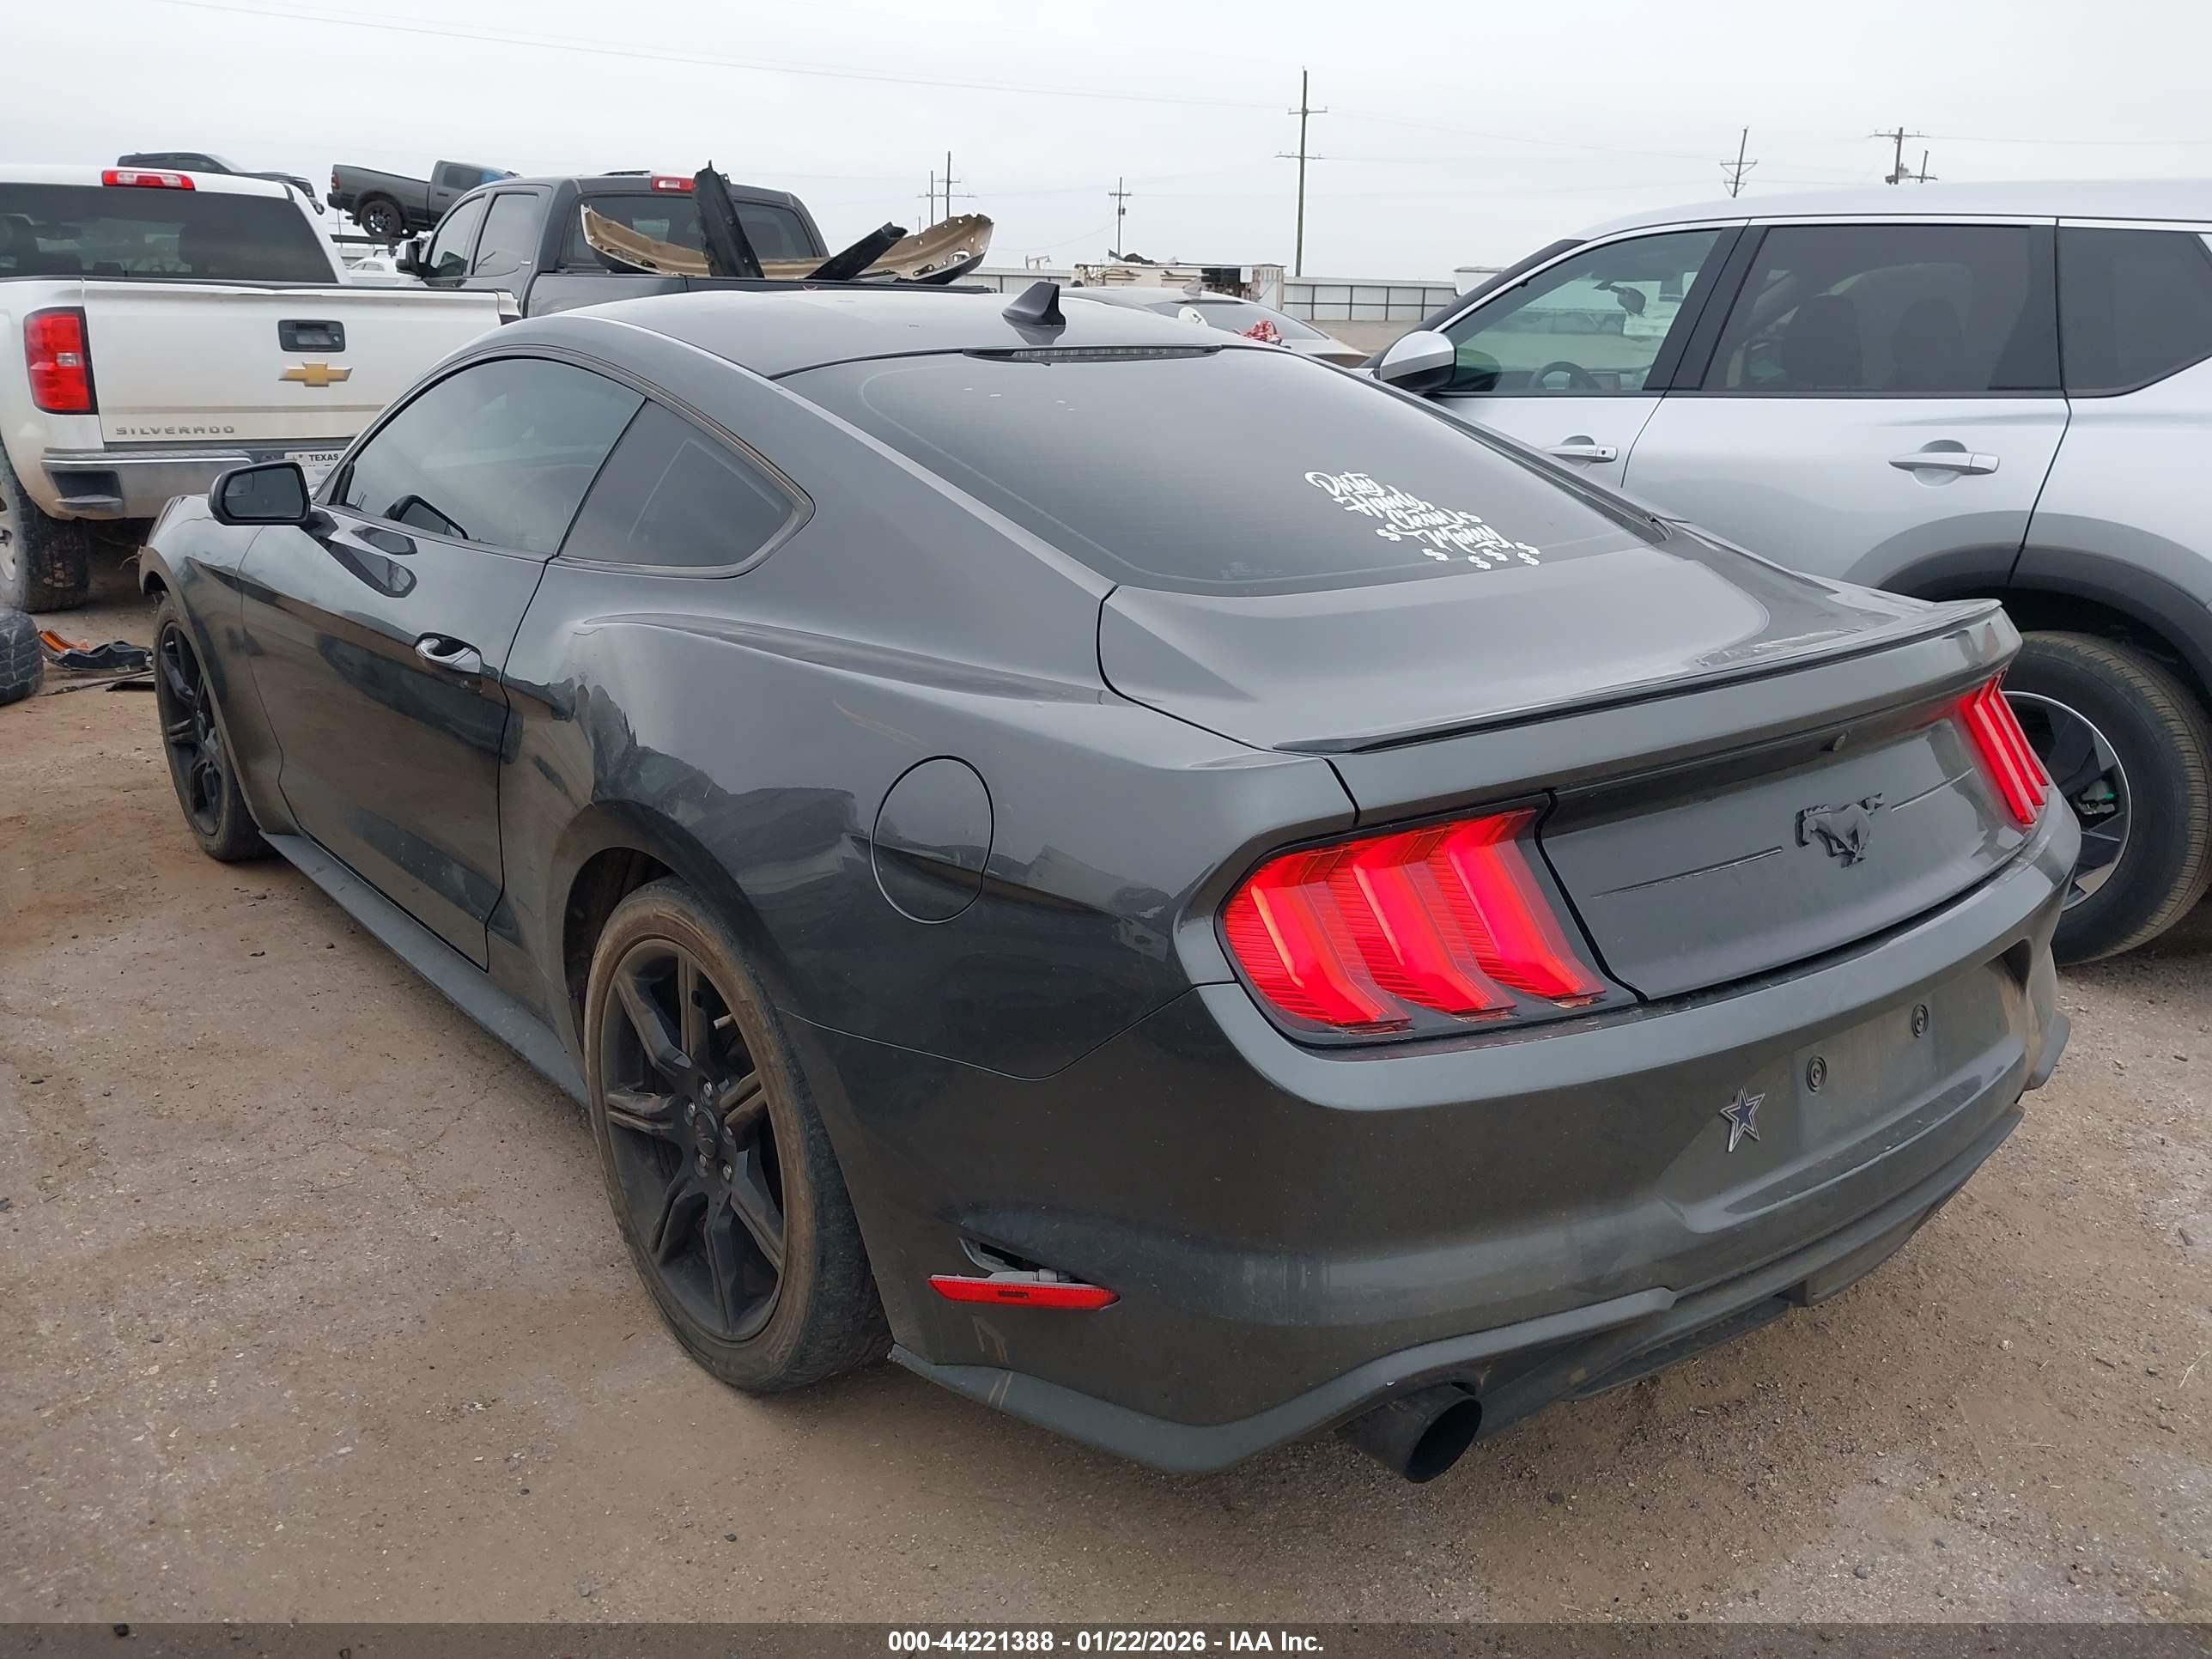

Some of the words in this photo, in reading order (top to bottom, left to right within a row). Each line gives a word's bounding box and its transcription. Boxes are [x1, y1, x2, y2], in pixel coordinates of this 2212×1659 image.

[116, 426, 235, 435] SILVERADO
[1304, 471, 1386, 497] Dirty
[1332, 484, 1436, 520] Hands
